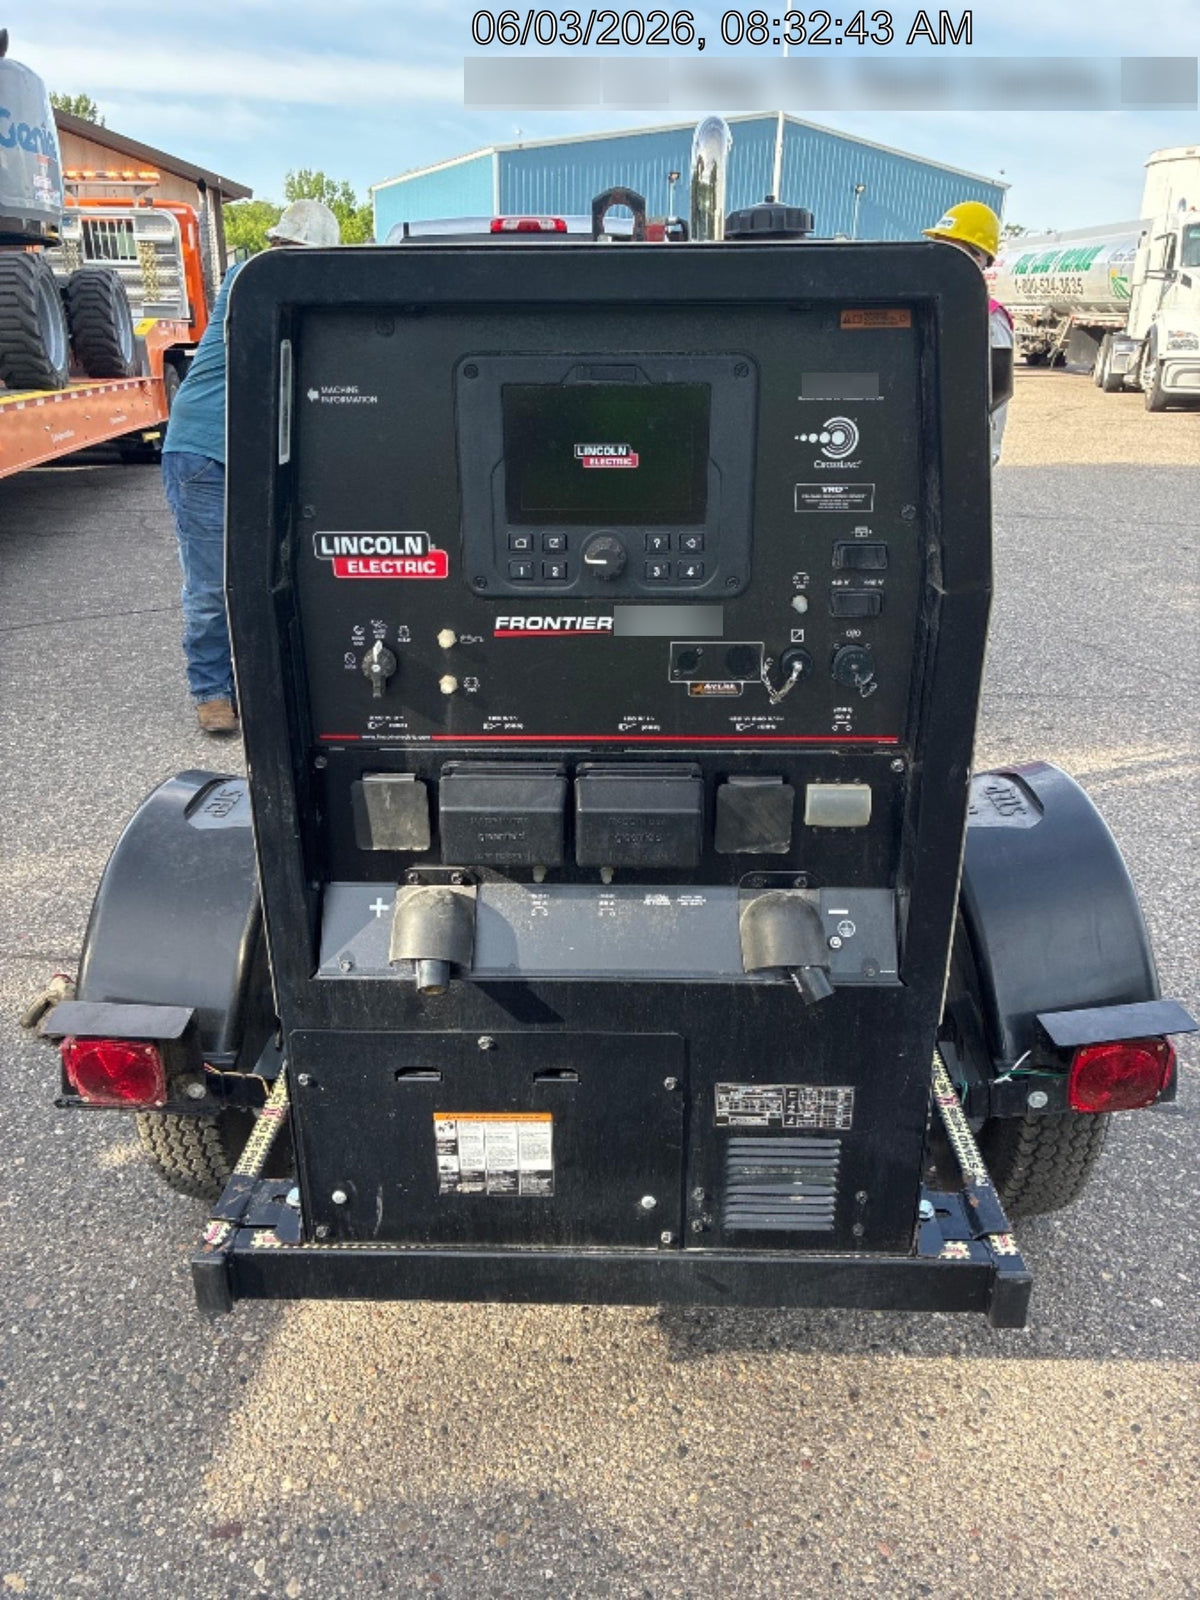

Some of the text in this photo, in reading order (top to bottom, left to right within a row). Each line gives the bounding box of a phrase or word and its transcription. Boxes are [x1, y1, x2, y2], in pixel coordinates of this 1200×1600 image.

[577, 445, 627, 456] LINCOLN
[589, 457, 633, 465] ELECTRIC
[320, 536, 423, 556] LINCOLN
[346, 560, 437, 574] ELECTRIC
[551, 566, 559, 577] 2
[653, 566, 695, 577] 3 4
[494, 616, 614, 630] FRONTIER
